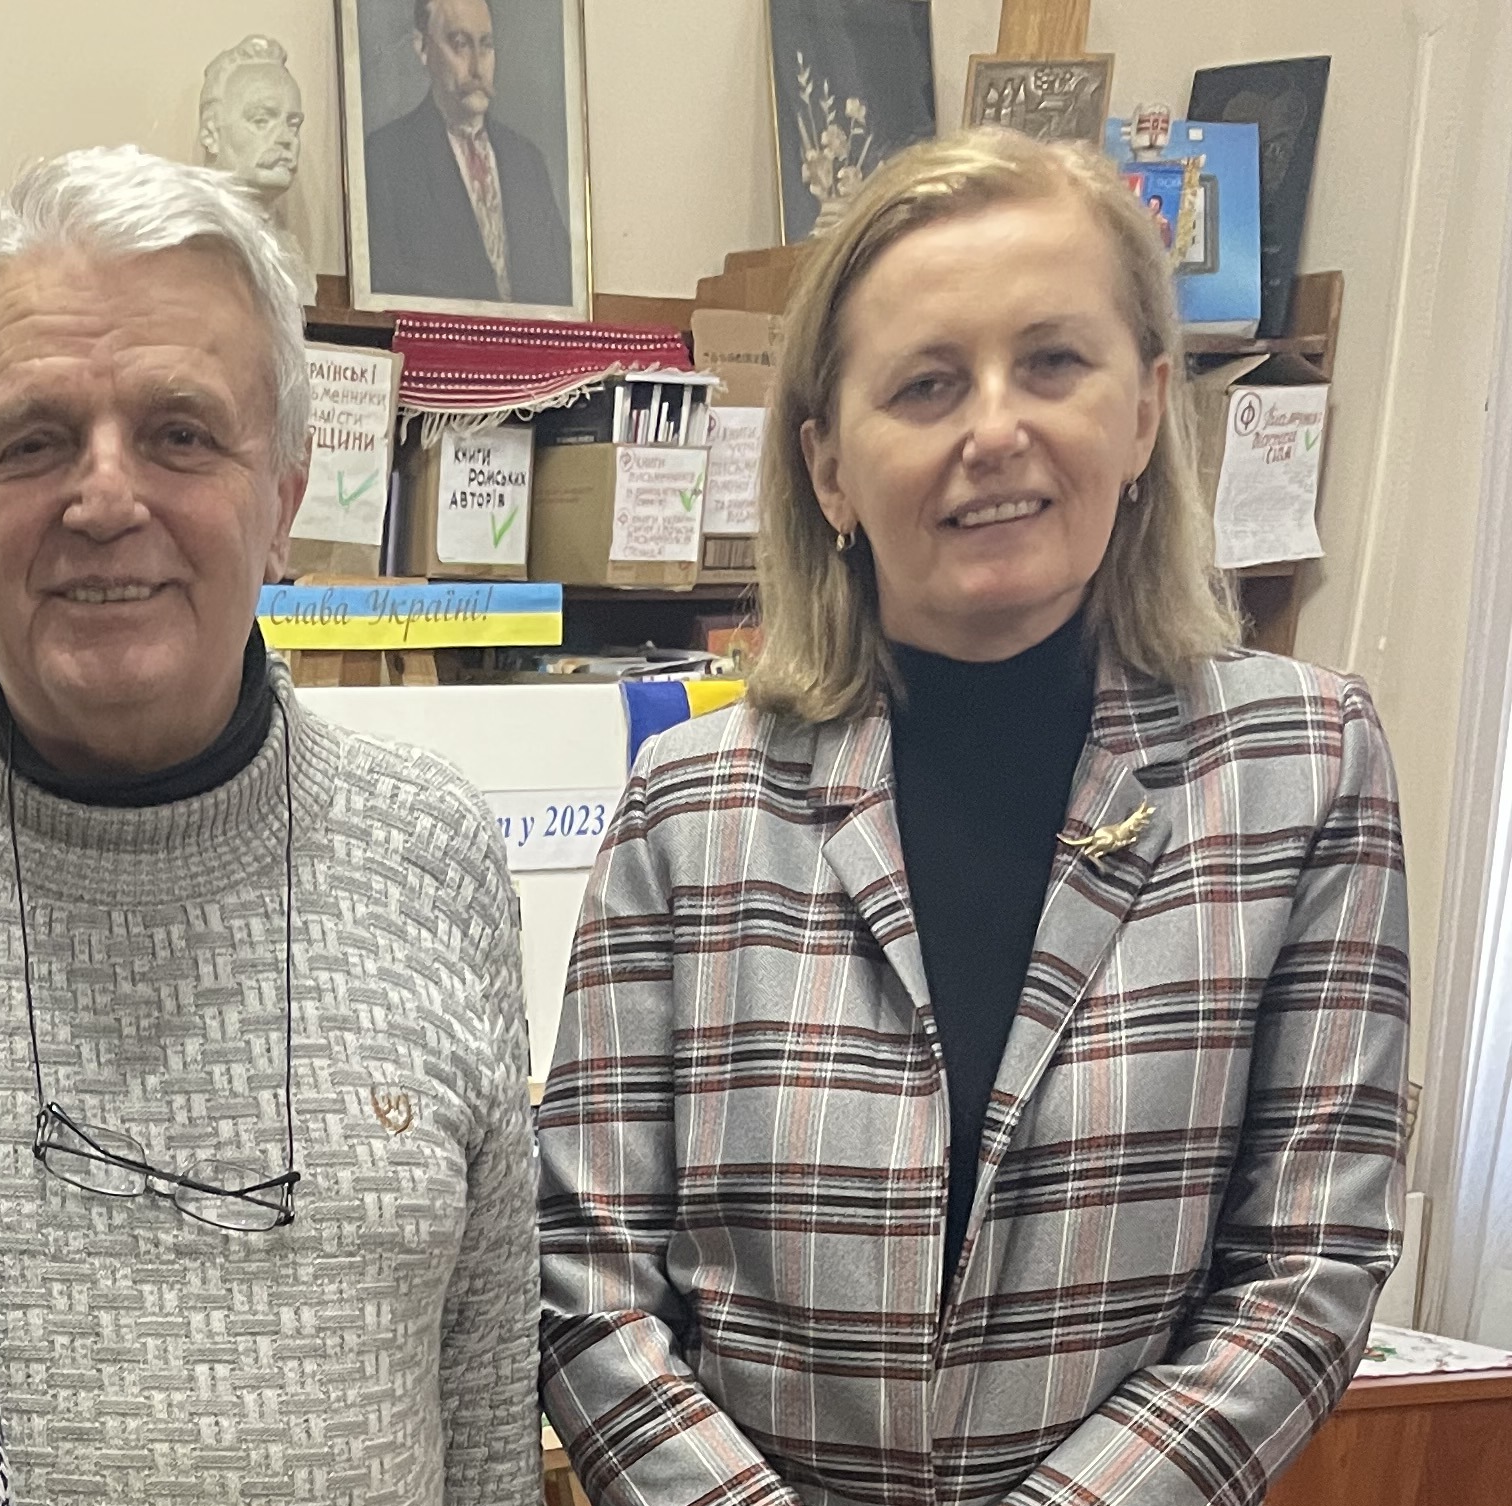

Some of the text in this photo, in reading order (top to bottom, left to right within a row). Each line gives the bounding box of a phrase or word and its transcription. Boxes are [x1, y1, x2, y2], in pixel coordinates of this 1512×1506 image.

[449, 488, 506, 510] АВТОРІВ
[269, 584, 494, 642] Слава Україні!
[543, 803, 605, 838] 2023
